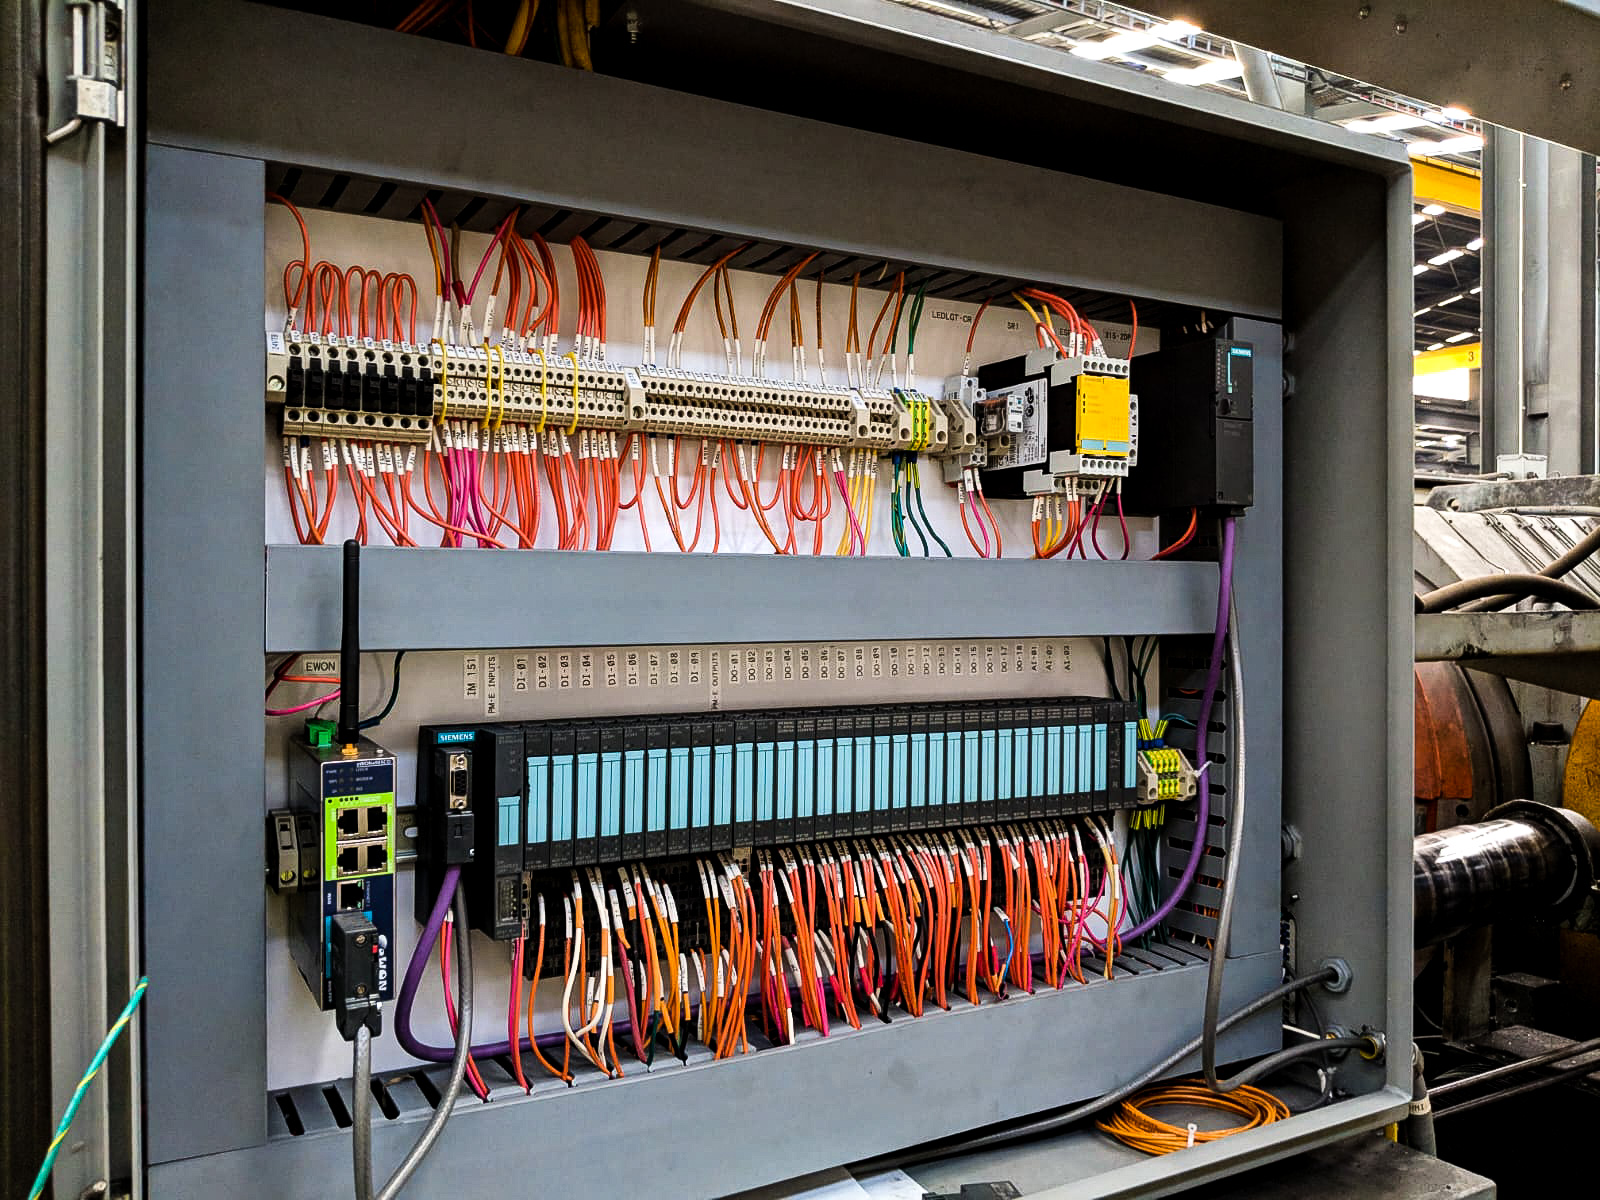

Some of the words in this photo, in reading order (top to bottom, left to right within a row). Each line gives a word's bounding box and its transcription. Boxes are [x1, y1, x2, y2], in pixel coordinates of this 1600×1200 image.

[1468, 351, 1474, 362] 3
[306, 660, 336, 673] EWON
[466, 658, 476, 676] 151
[488, 656, 496, 688] INPUTS
[516, 658, 526, 690] DI-01
[538, 655, 547, 688] DI-02
[560, 655, 569, 688] DI-03
[582, 654, 590, 686] DI-04
[607, 654, 616, 686] DI-05
[628, 654, 637, 685] DI-06
[650, 654, 658, 686] DI-07
[670, 652, 678, 683] DI-08
[690, 652, 698, 683] DI-09
[730, 654, 738, 682] DO-01
[748, 651, 756, 681] DO-02
[765, 650, 773, 680] DO-03
[784, 650, 792, 679] DO-04
[820, 650, 828, 678] DO-06
[872, 648, 880, 676] DO-09
[466, 682, 476, 696] IM
[440, 732, 474, 743] SIEMENS
